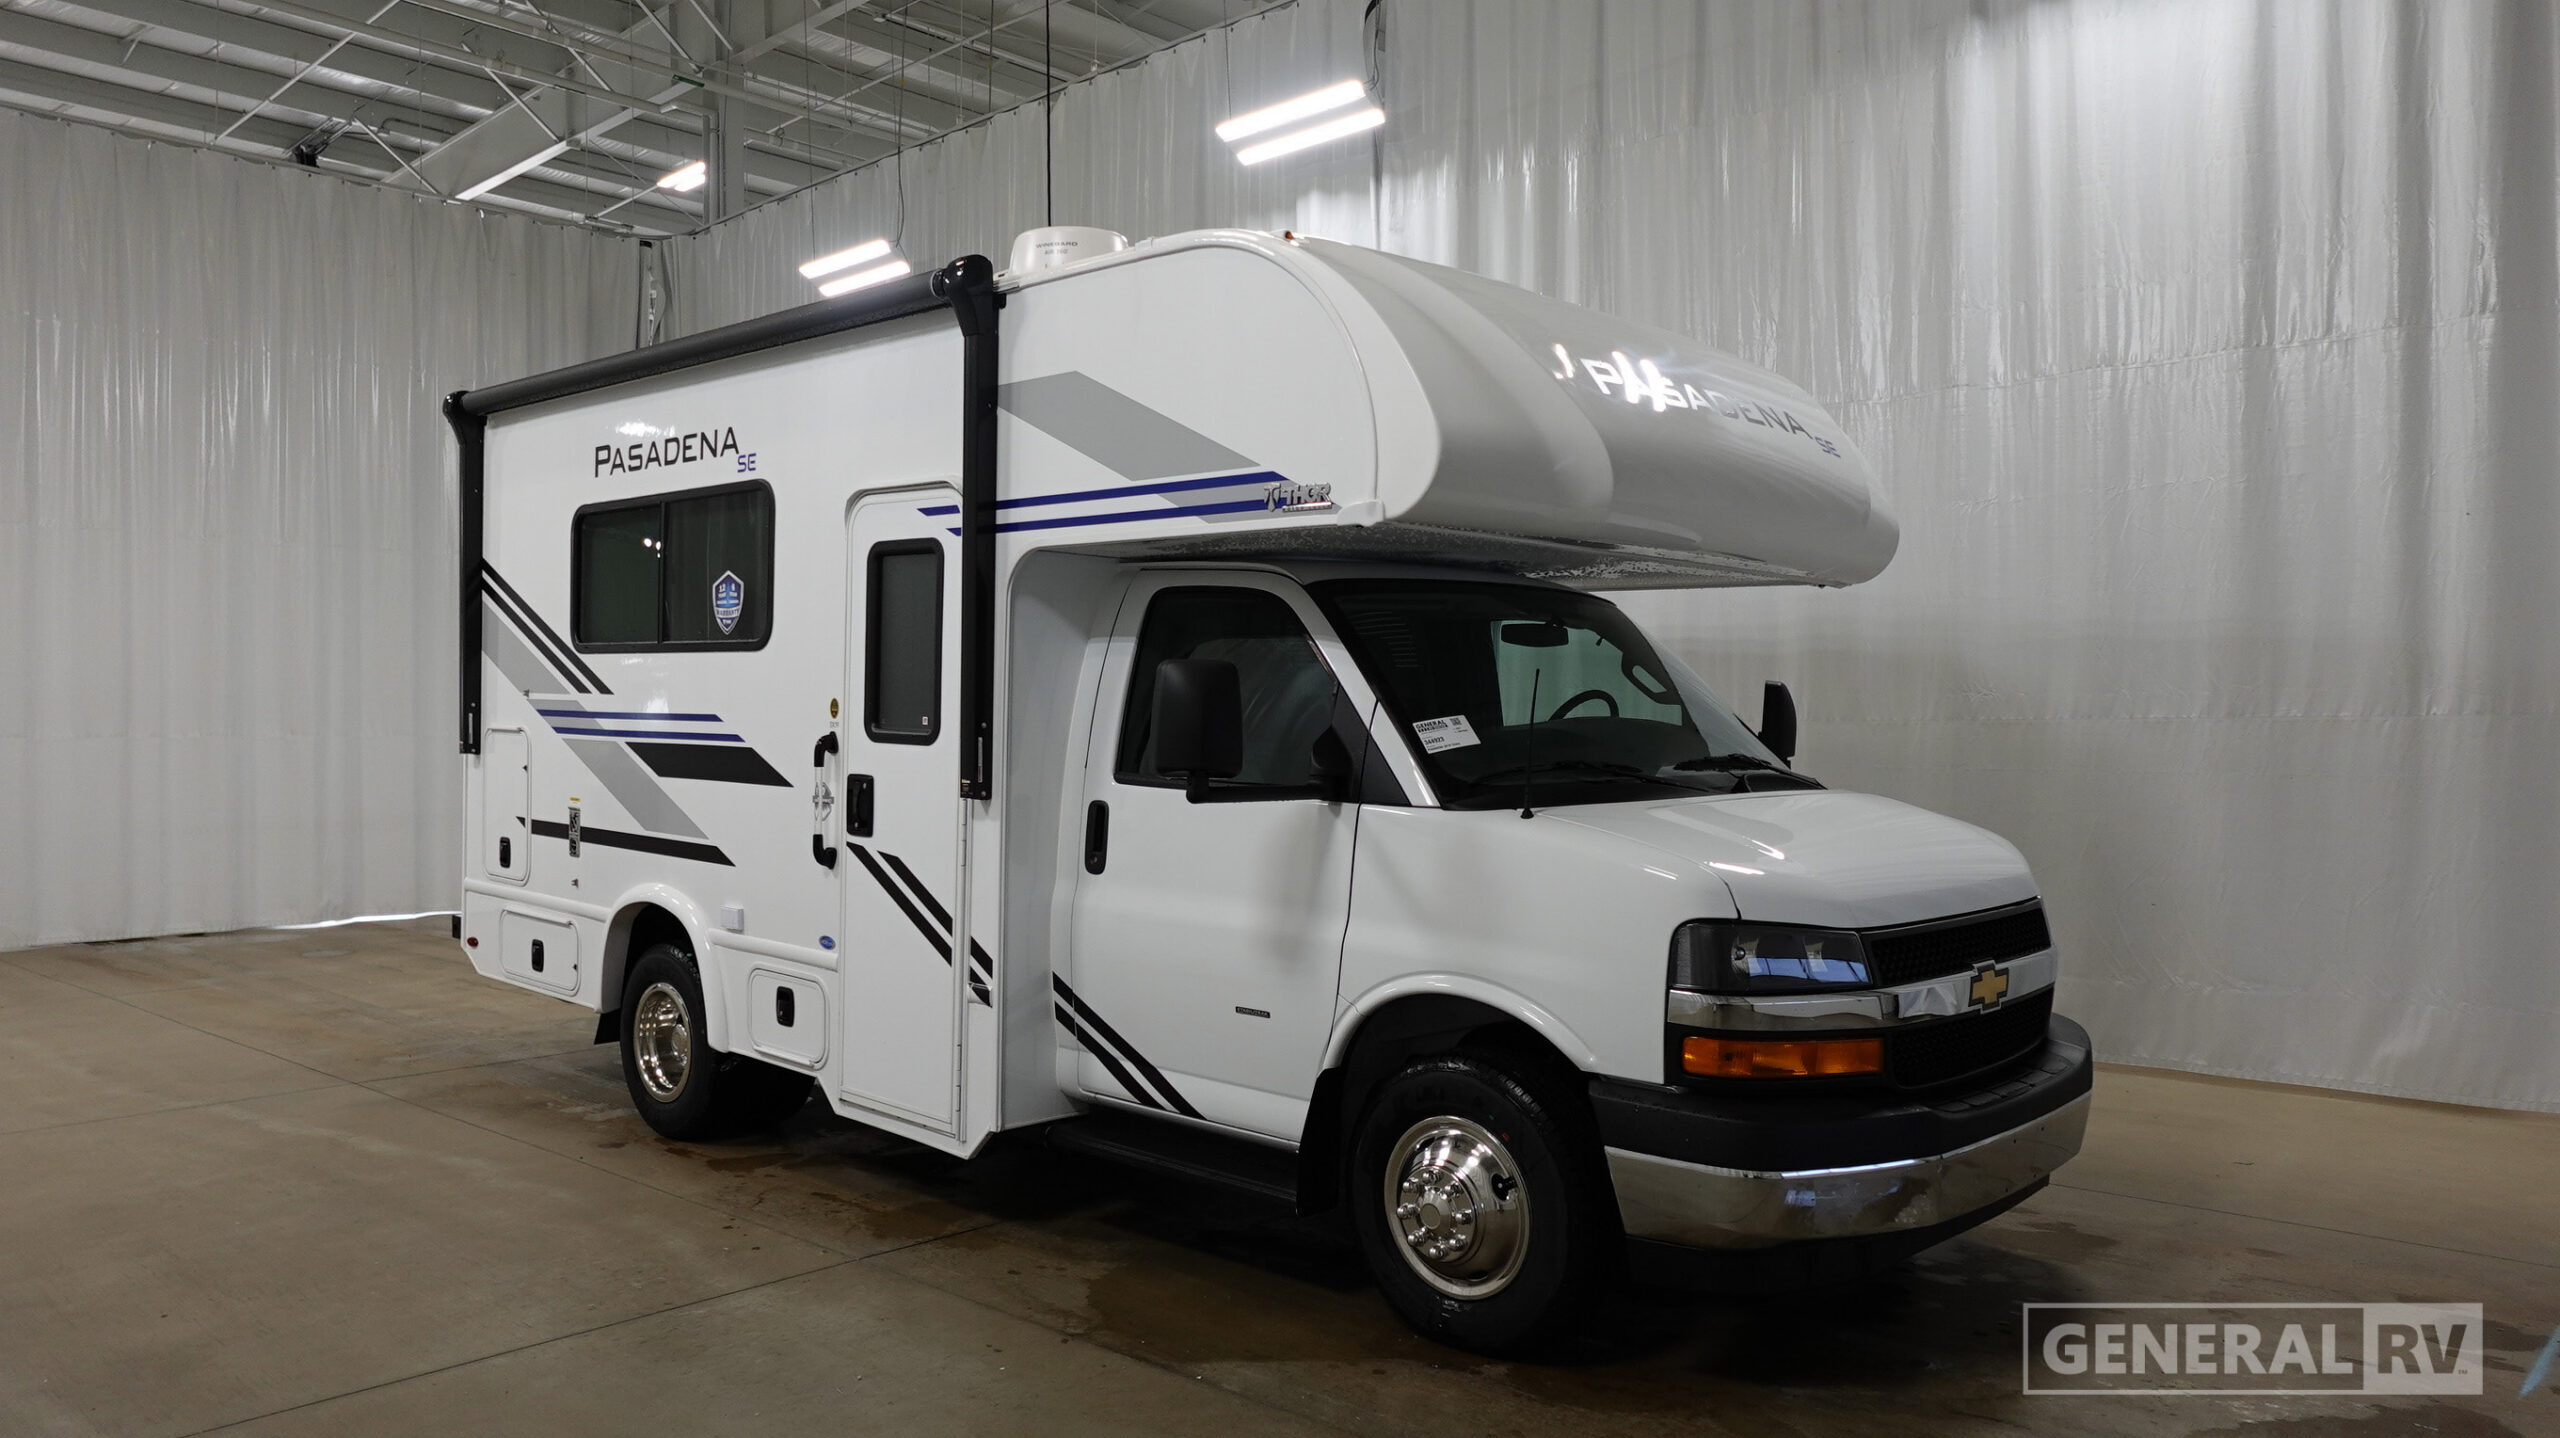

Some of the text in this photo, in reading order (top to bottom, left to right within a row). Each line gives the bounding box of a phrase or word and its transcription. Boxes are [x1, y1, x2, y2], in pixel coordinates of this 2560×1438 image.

[1580, 357, 1841, 458] PASADENA SE
[594, 426, 757, 478] PASADENA SE
[1282, 483, 1331, 505] THOR
[1416, 720, 1447, 729] GENERAL
